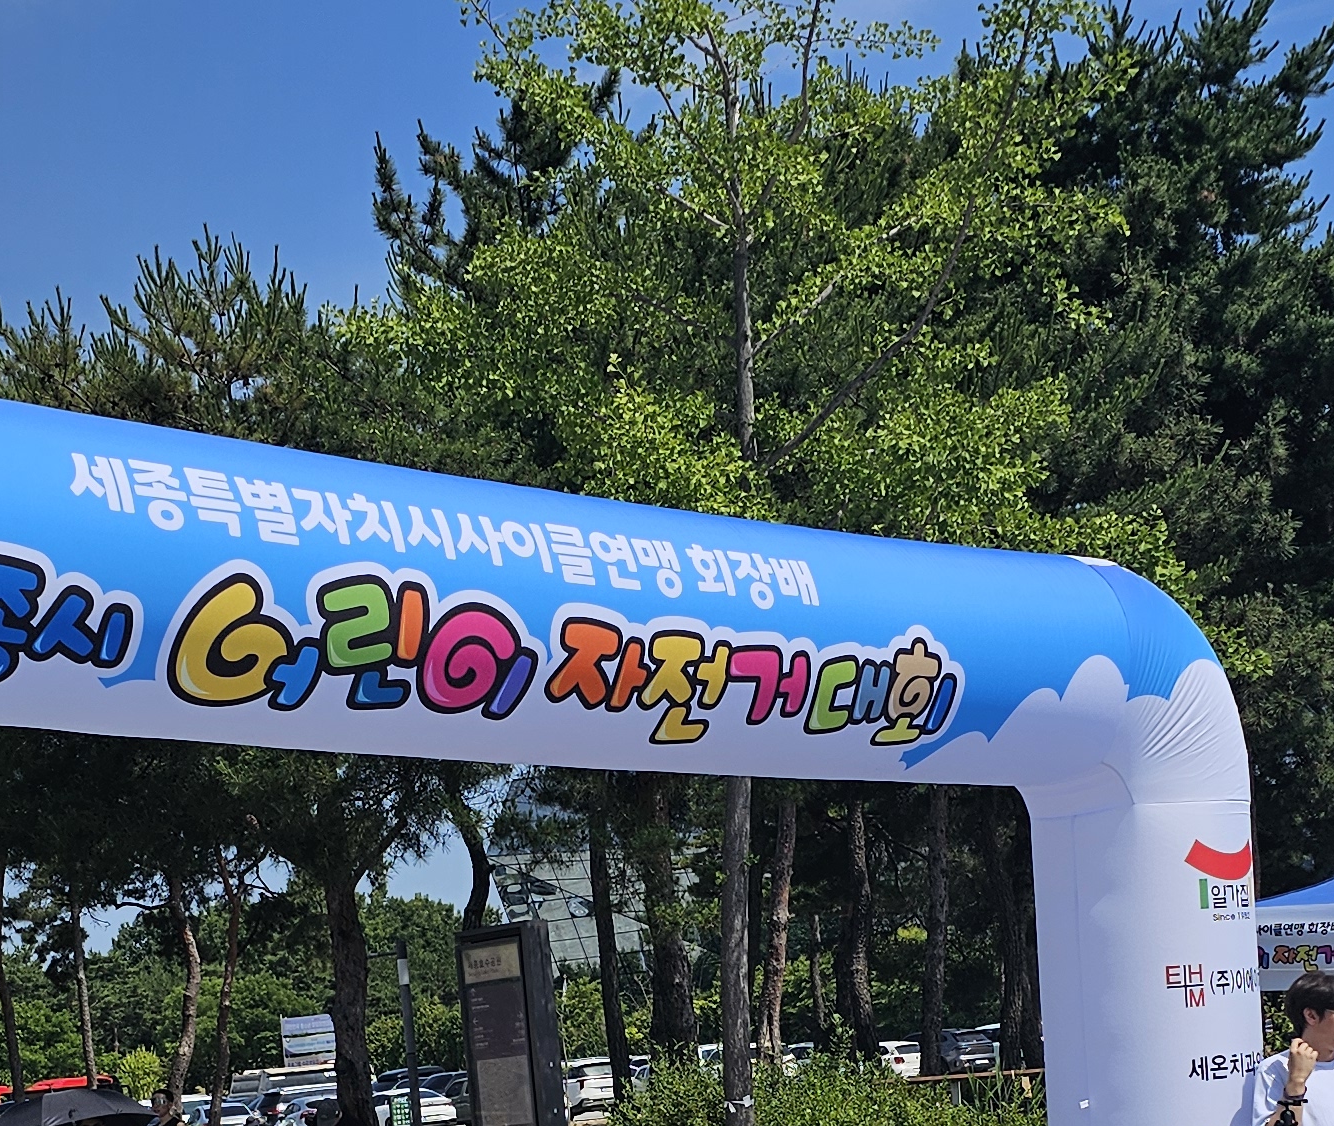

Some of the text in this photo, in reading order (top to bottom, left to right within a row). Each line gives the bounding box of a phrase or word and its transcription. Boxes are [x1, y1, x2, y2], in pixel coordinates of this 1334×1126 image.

[69, 452, 820, 609] 세종특별자치시사이클연맹 회장배
[169, 572, 539, 720] 어린이
